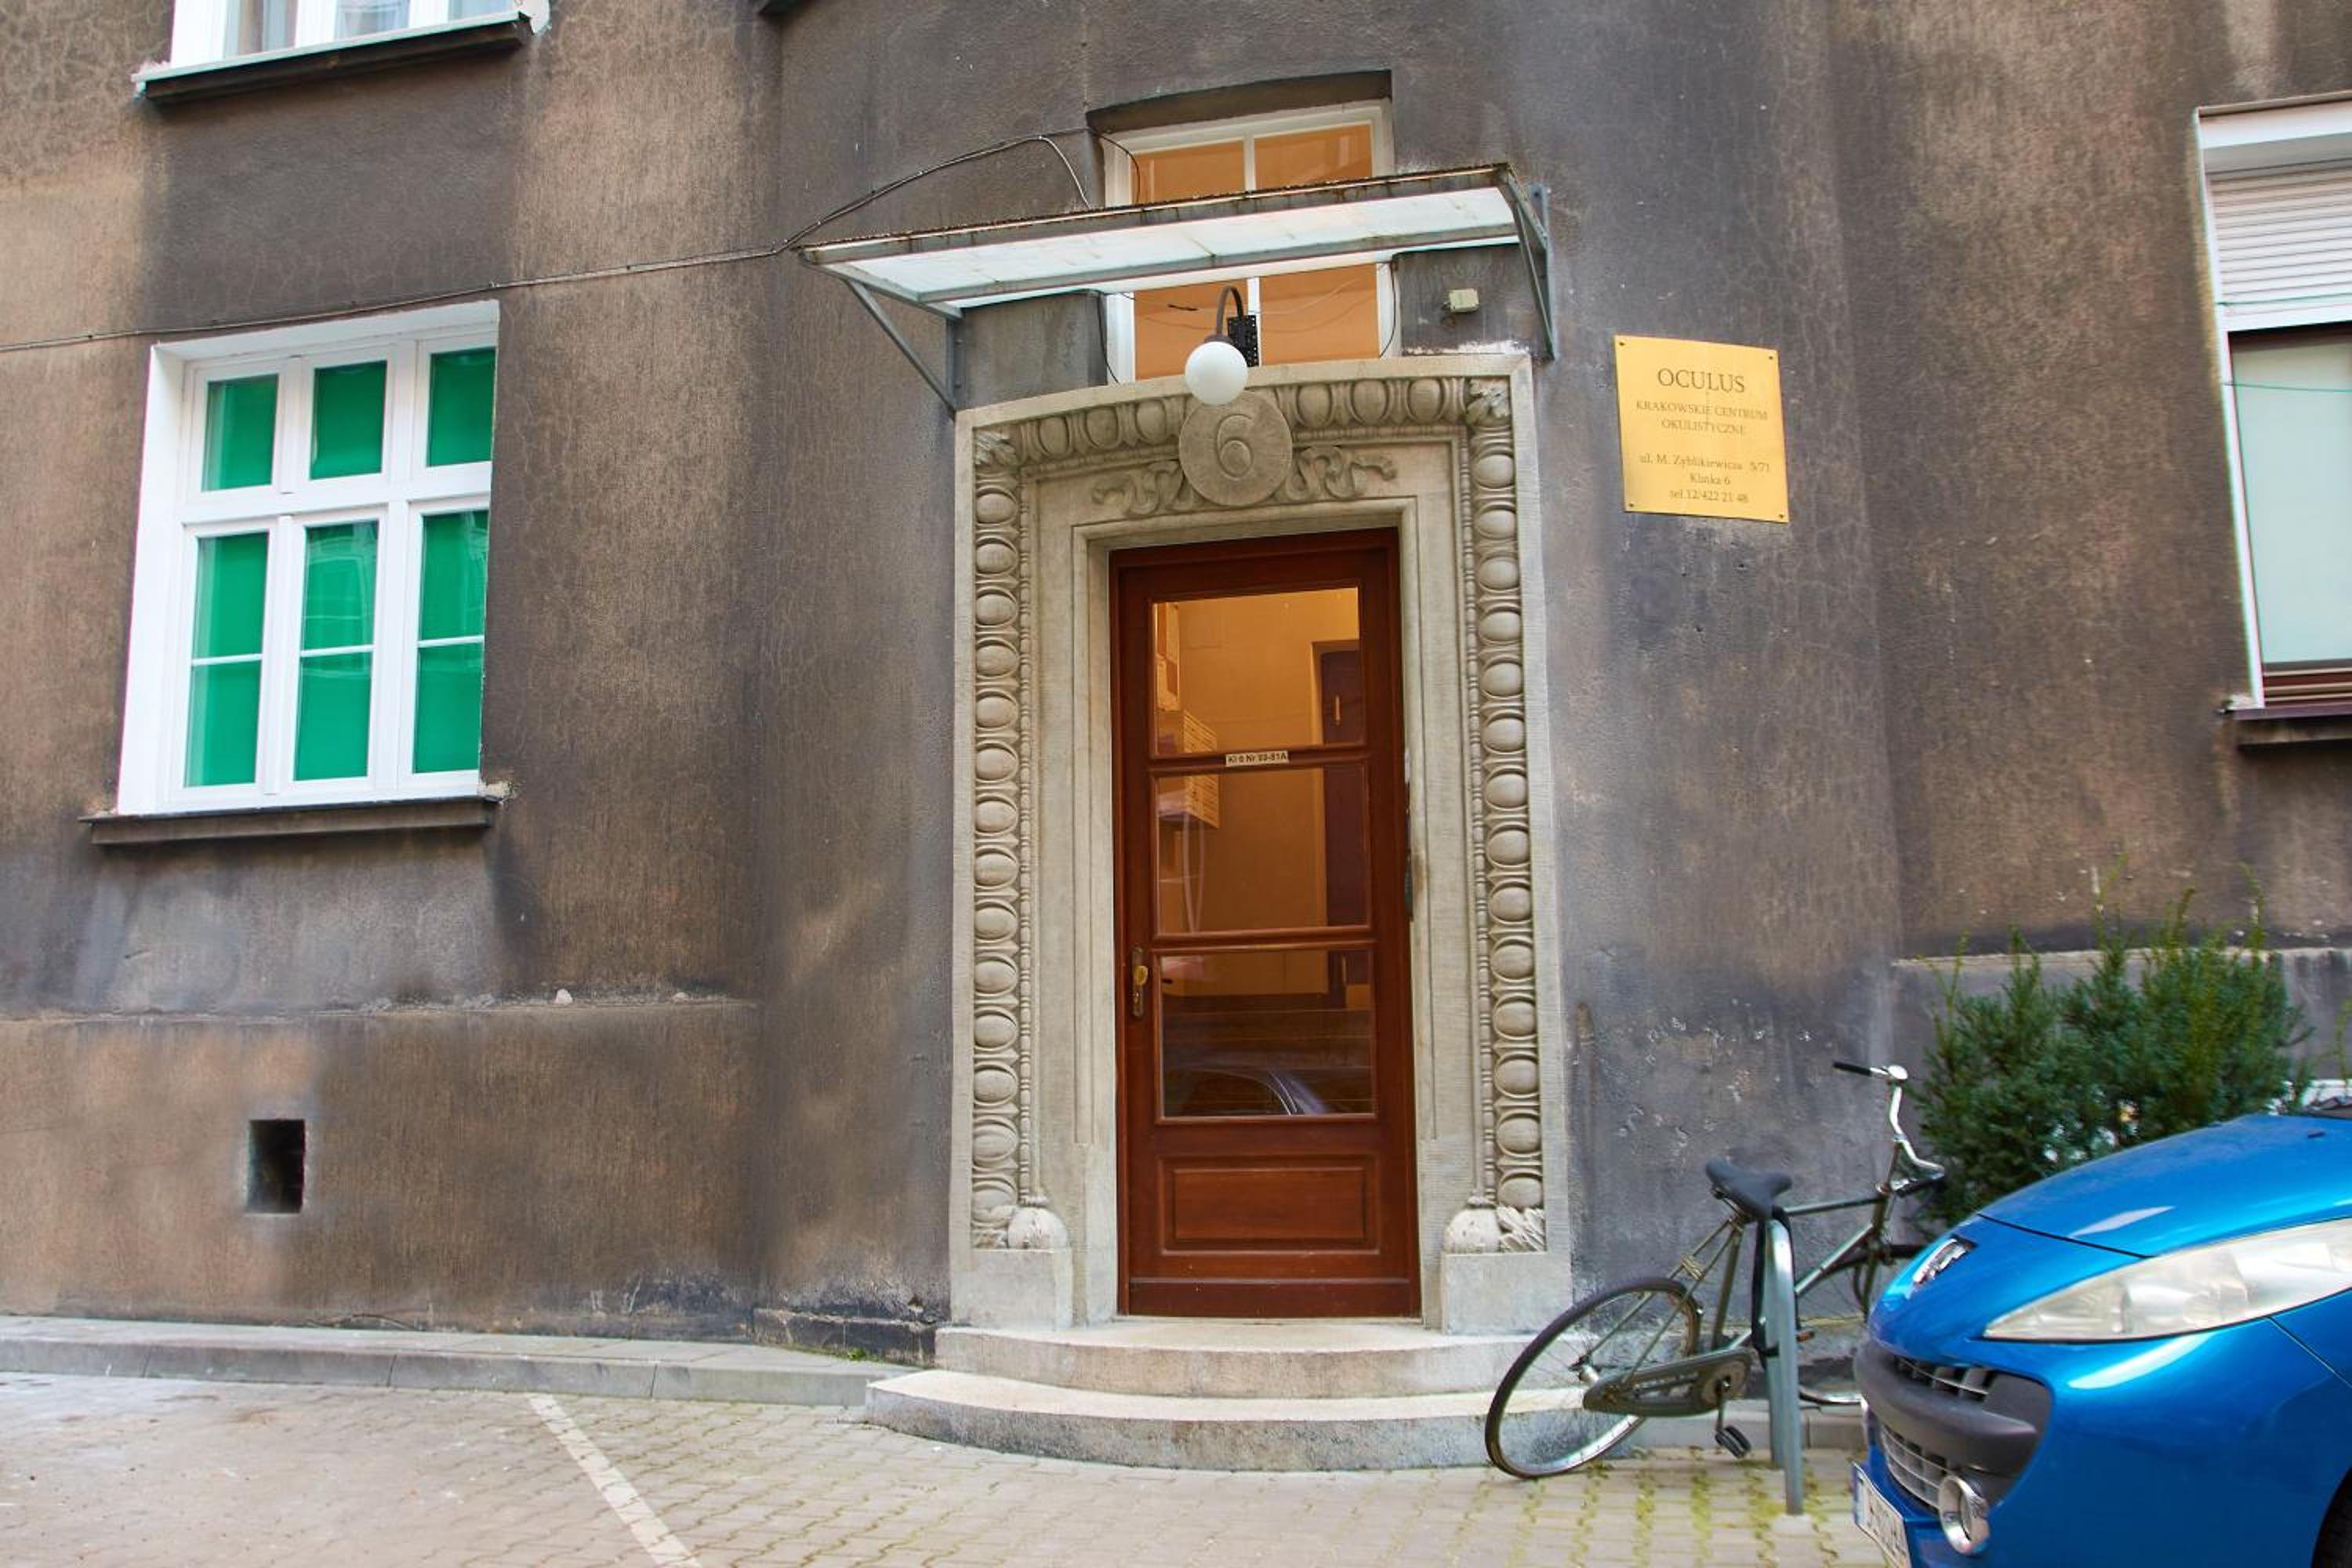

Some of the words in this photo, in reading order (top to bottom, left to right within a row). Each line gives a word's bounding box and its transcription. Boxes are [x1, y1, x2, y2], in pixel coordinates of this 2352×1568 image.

[1657, 368, 1745, 393] OCULUS
[1635, 401, 1712, 416] KRAKOWSKIE
[1715, 406, 1768, 421] CENTRUM
[1661, 419, 1747, 435] OKULISTYCZNE
[1215, 412, 1254, 481] 6
[1657, 453, 1671, 465] M.
